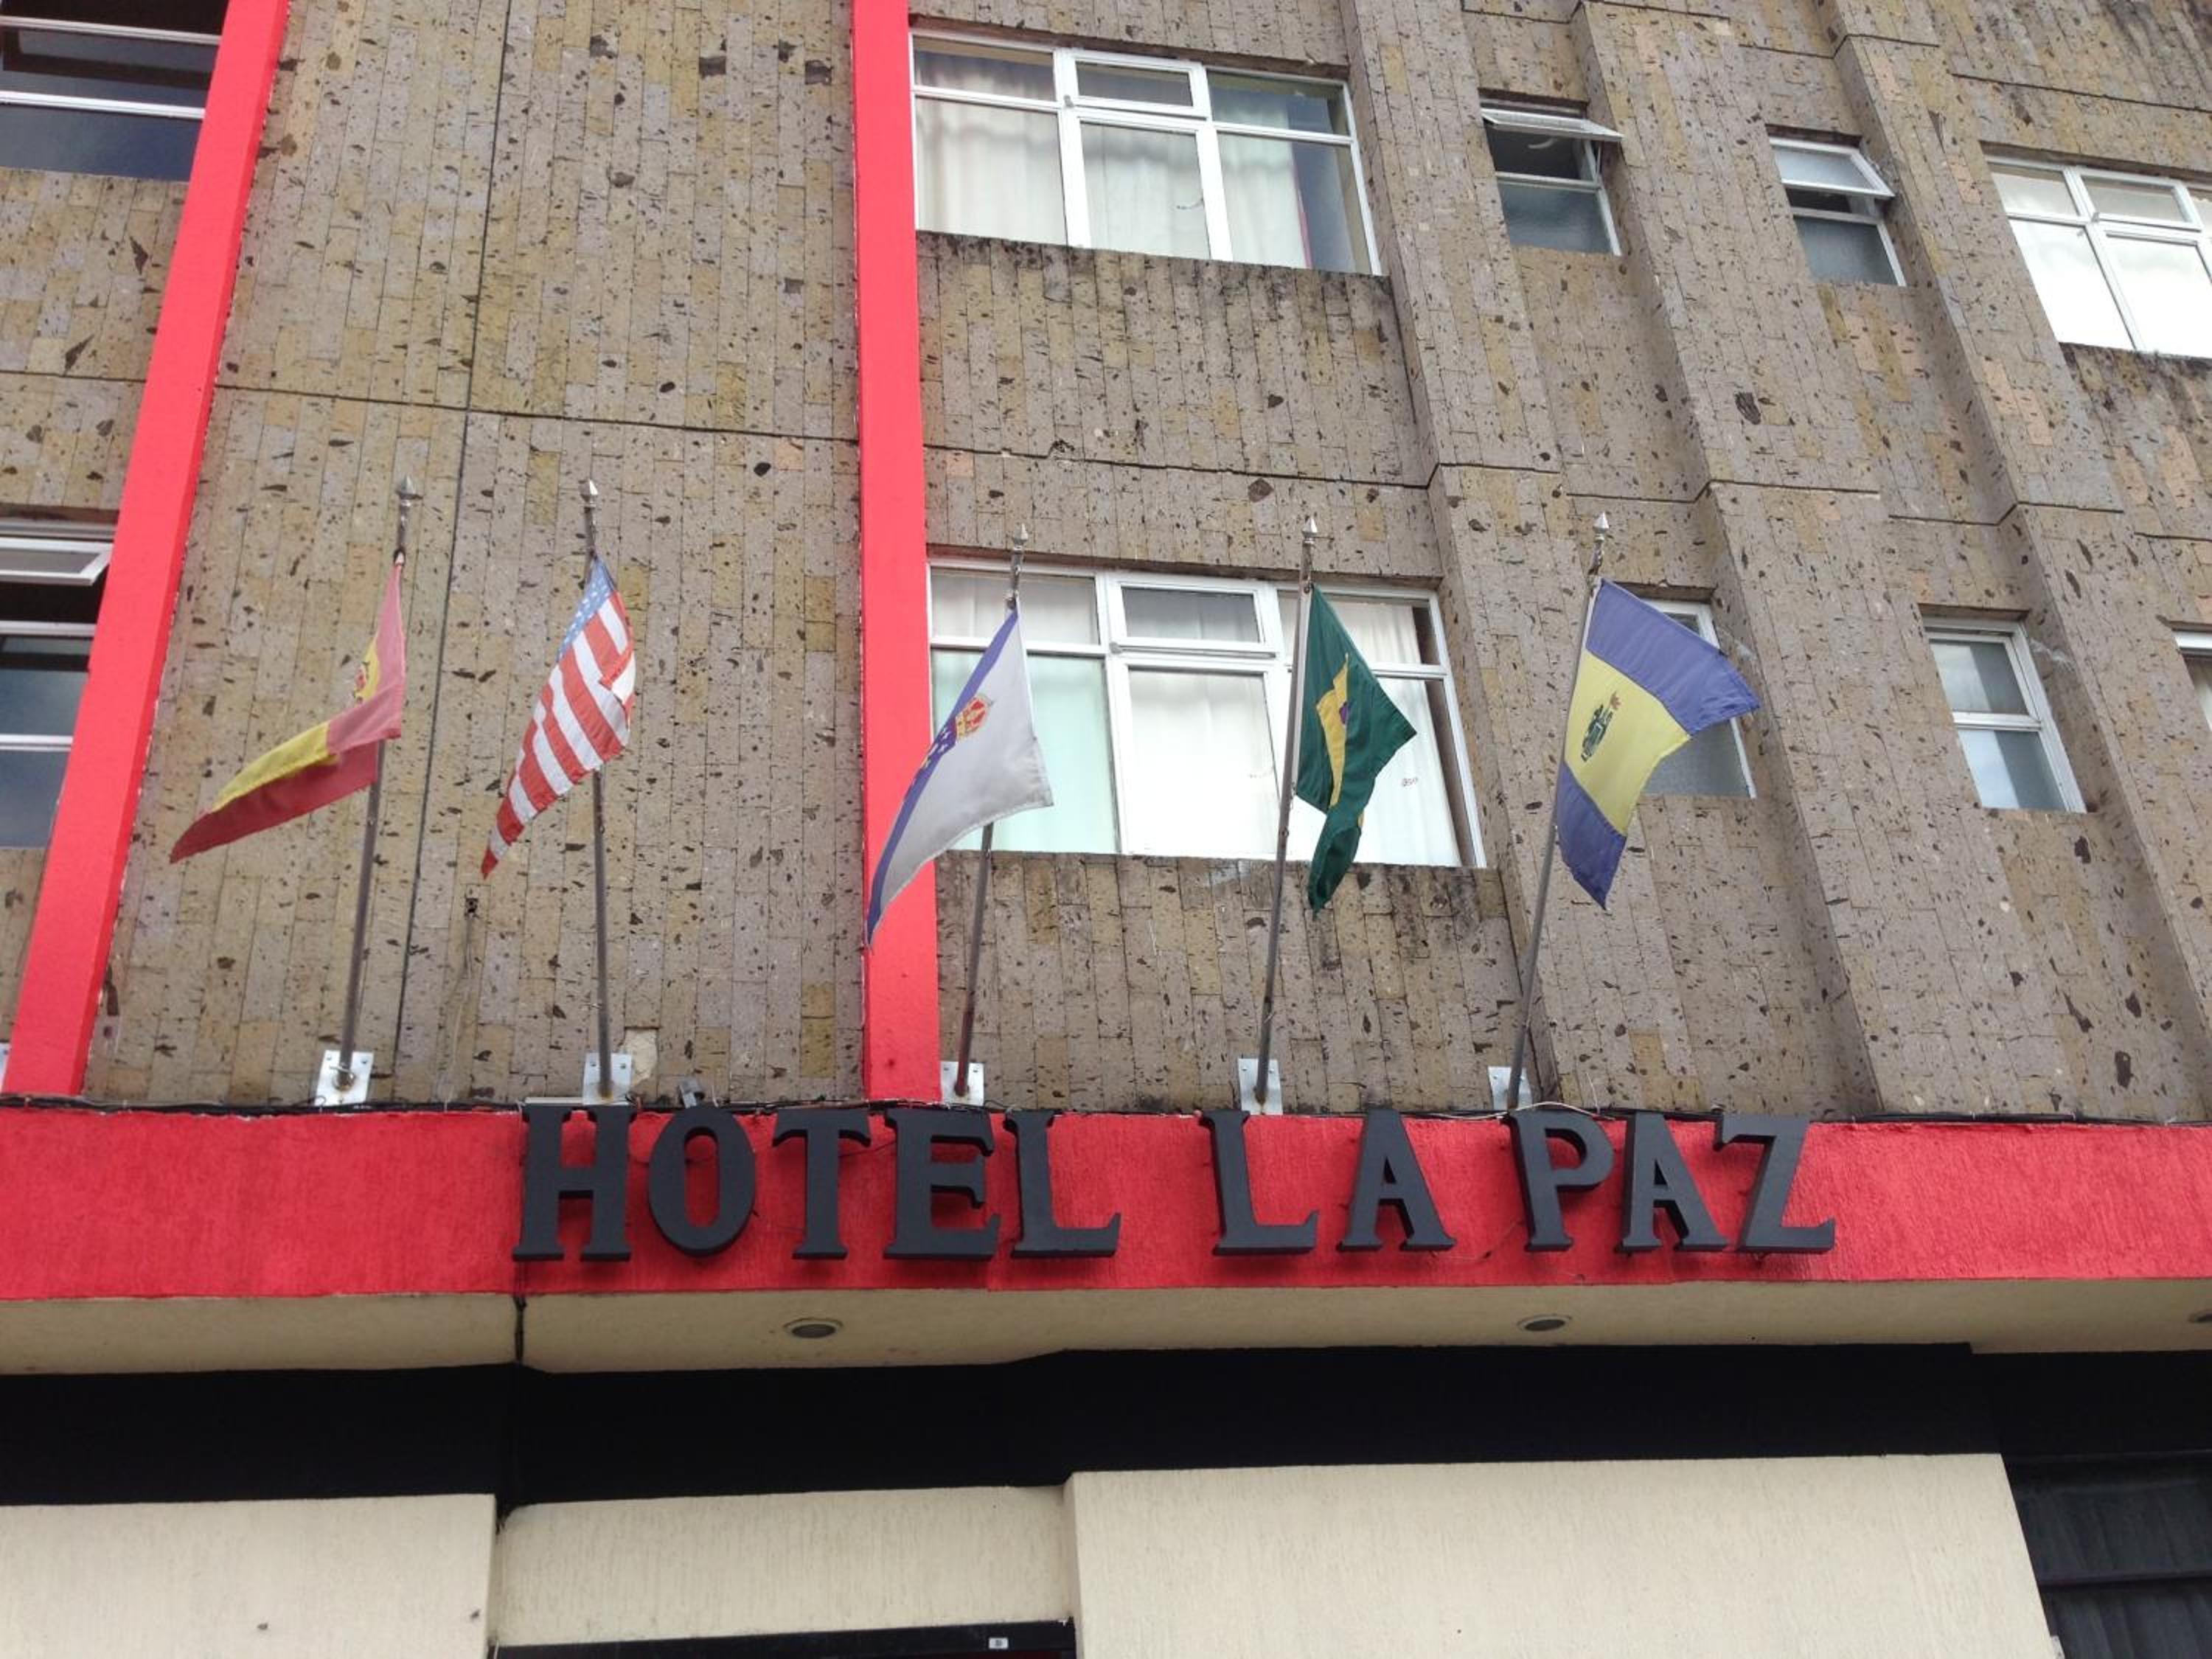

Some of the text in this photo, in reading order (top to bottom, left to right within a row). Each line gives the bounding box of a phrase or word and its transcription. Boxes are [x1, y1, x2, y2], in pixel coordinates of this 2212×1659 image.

[512, 1105, 1835, 1262] HOTEL LA PAZ
